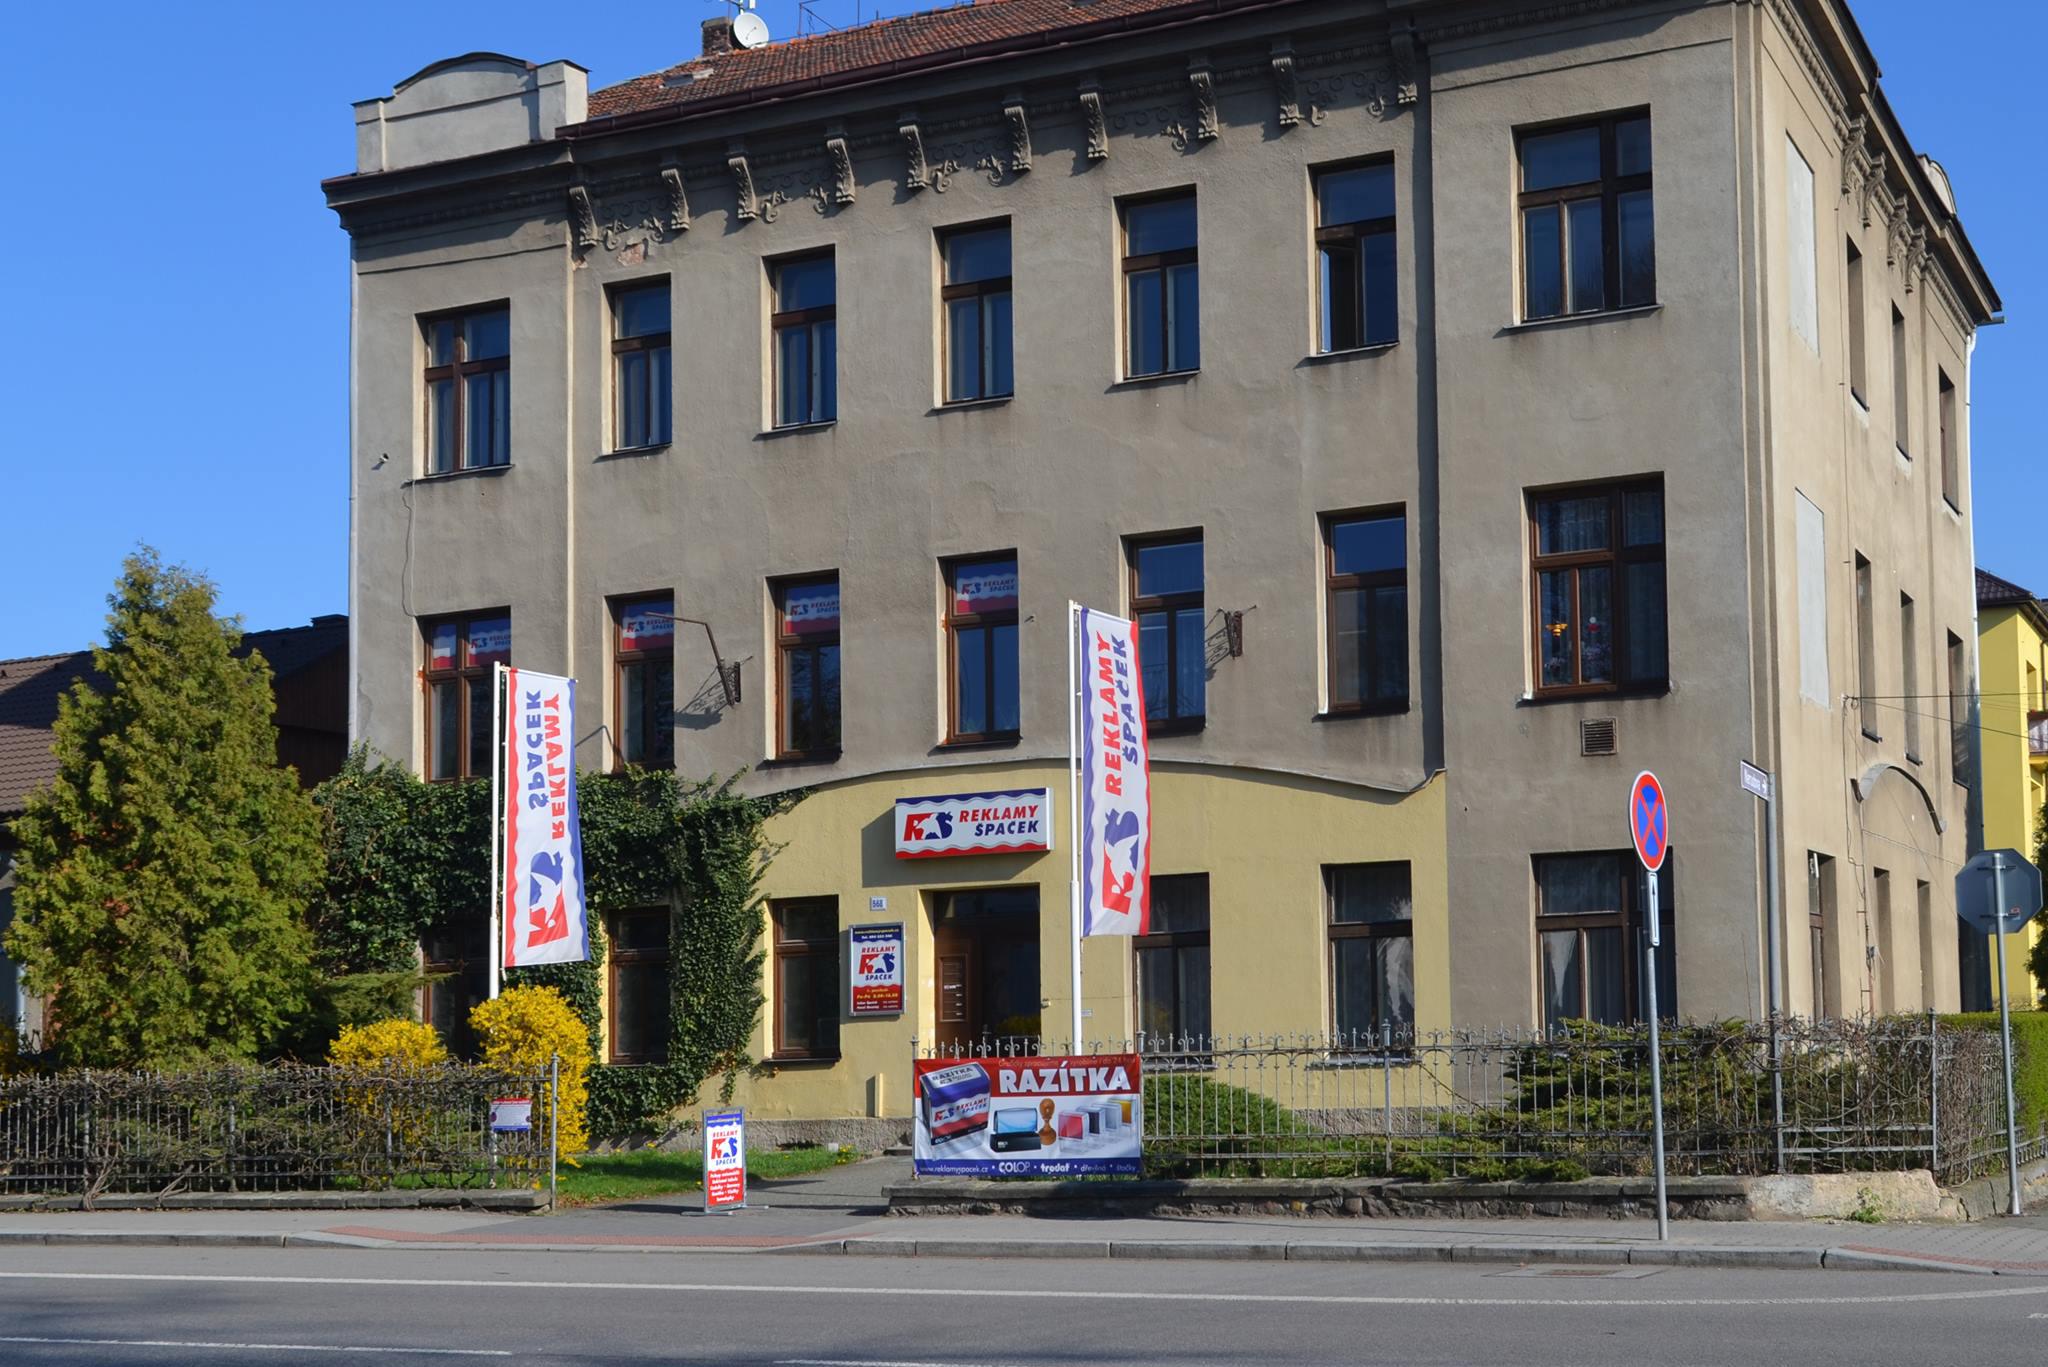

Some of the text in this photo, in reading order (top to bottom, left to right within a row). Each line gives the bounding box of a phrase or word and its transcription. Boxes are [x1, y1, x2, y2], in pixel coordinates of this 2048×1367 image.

[1111, 633, 1138, 766] ŠPAČEK
[1096, 631, 1122, 797] REKLAMY
[959, 805, 1039, 823] REKLAMY
[862, 946, 895, 954] REKLAMY
[999, 1061, 1131, 1093] RAZÍTKA
[956, 1097, 988, 1110] REKLAMY
[1041, 1163, 1070, 1174] trodat
